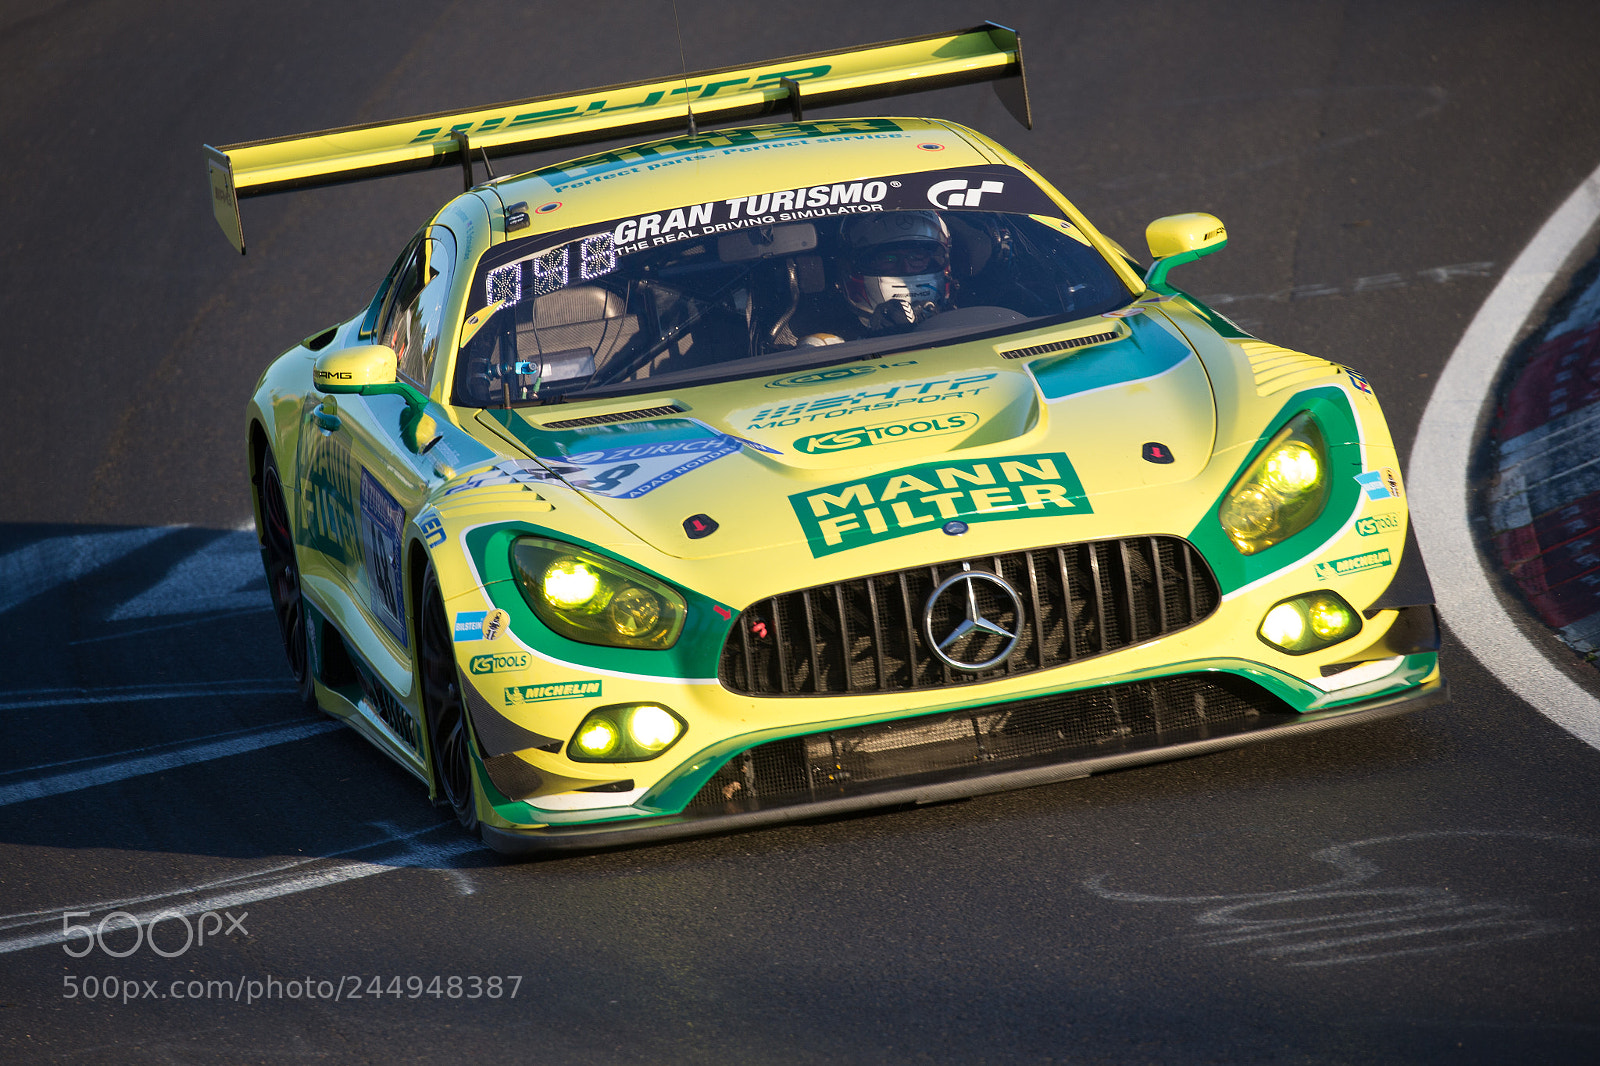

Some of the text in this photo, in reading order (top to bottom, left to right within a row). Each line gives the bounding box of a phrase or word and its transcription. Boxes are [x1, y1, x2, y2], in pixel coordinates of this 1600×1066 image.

[554, 167, 640, 194] Perfect
[722, 139, 810, 155] Perfect
[816, 132, 912, 144] service.
[613, 203, 716, 246] GRAN
[725, 180, 889, 219] TURISMO
[926, 179, 1005, 210] GT
[614, 202, 884, 257] THE REAL DRIVING SIMULATOR
[319, 371, 353, 380] AMG
[746, 386, 991, 430] MOTORSPORT
[604, 437, 727, 461] ZURICH
[629, 472, 674, 498] ADAC
[806, 458, 1062, 517] MANN
[817, 484, 1076, 546] FILTER
[455, 620, 483, 632] BILSTEIN
[525, 682, 600, 699] MICHELIN
